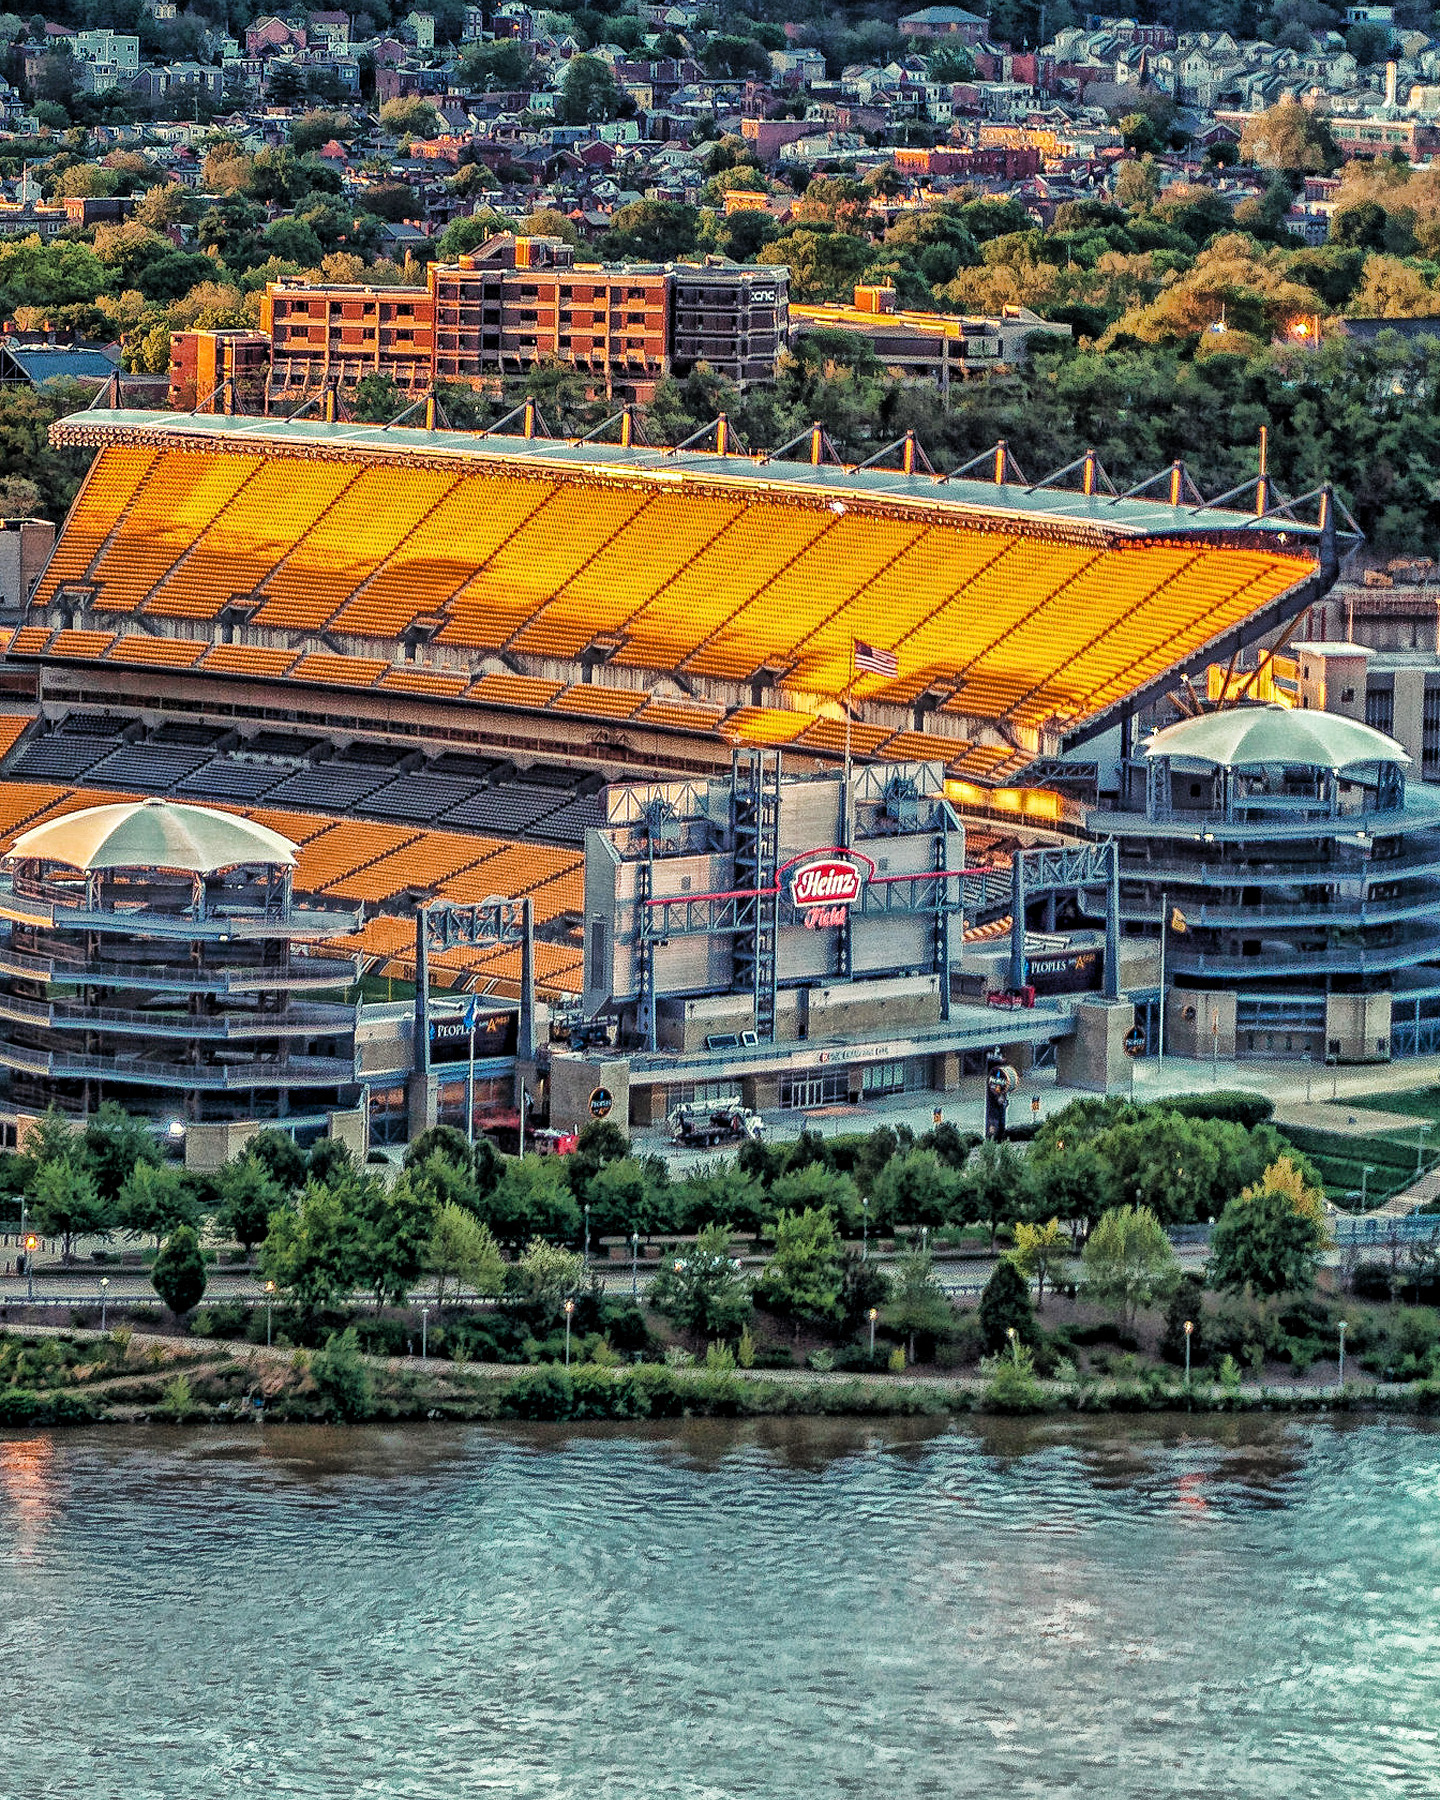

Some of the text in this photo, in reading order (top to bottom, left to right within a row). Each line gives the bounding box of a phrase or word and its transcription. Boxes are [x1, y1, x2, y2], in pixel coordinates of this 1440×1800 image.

[797, 868, 856, 898] Heinz
[804, 906, 847, 929] Field
[1031, 960, 1067, 974] PEOPLES
